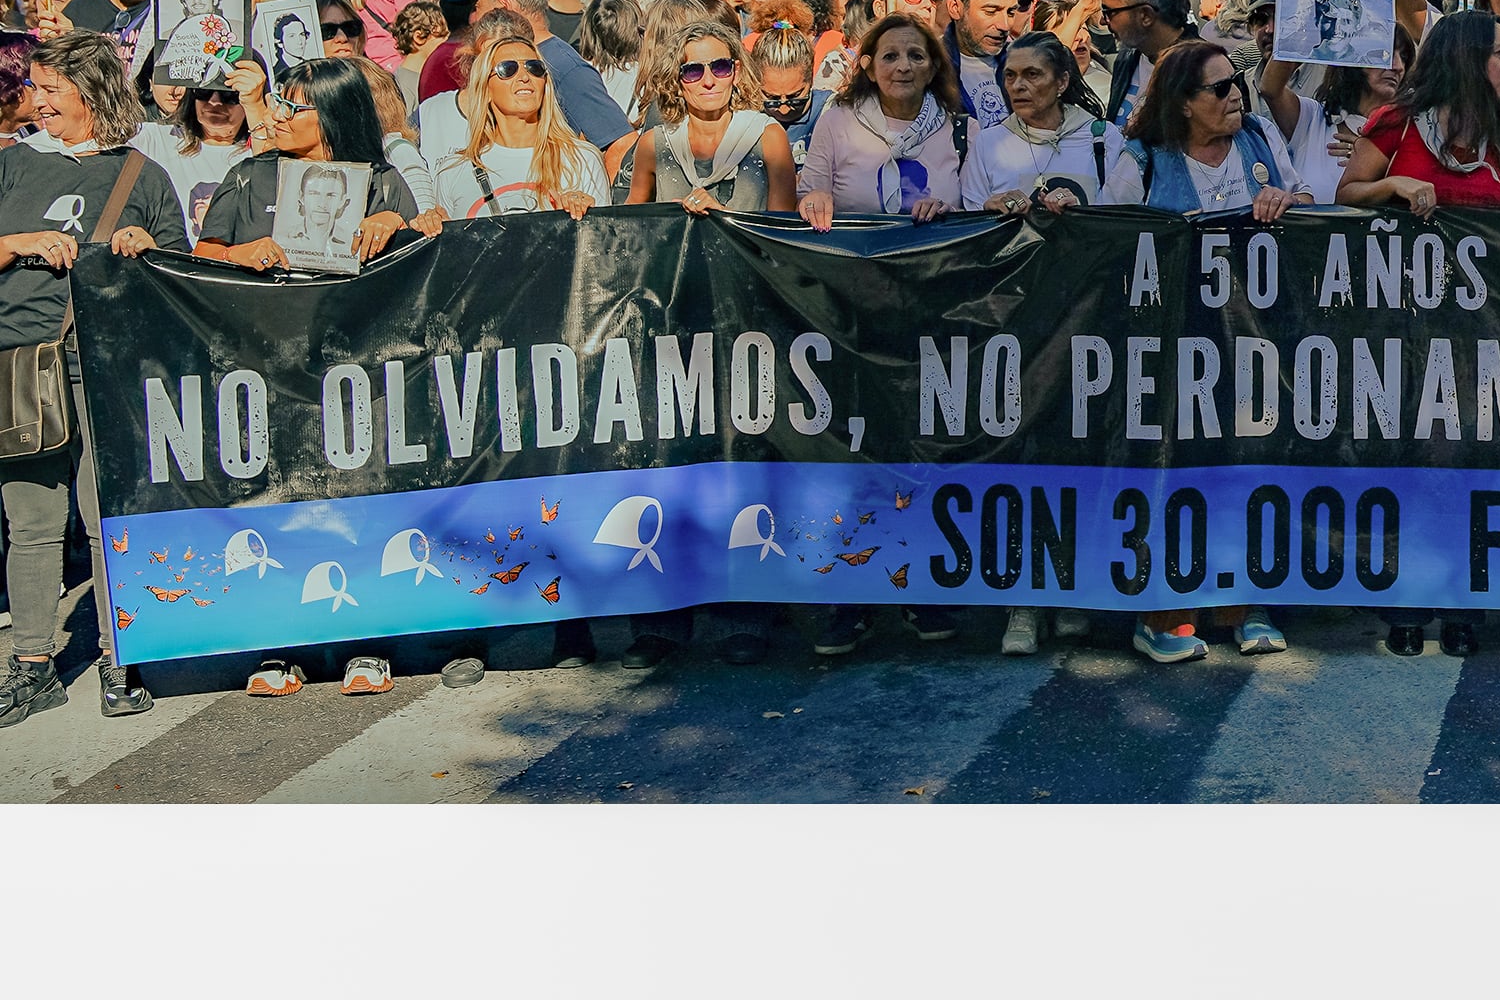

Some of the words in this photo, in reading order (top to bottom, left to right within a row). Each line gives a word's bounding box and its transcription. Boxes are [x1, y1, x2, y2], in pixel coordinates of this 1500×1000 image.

[1128, 231, 1162, 308] A
[1200, 231, 1280, 310] 50
[1318, 218, 1489, 313] AÑOS
[145, 369, 270, 484] NO
[322, 331, 866, 471] OLVIDAMOS,
[918, 333, 1022, 438] NO
[929, 483, 1077, 592] SON
[1110, 484, 1402, 595] 30.000
